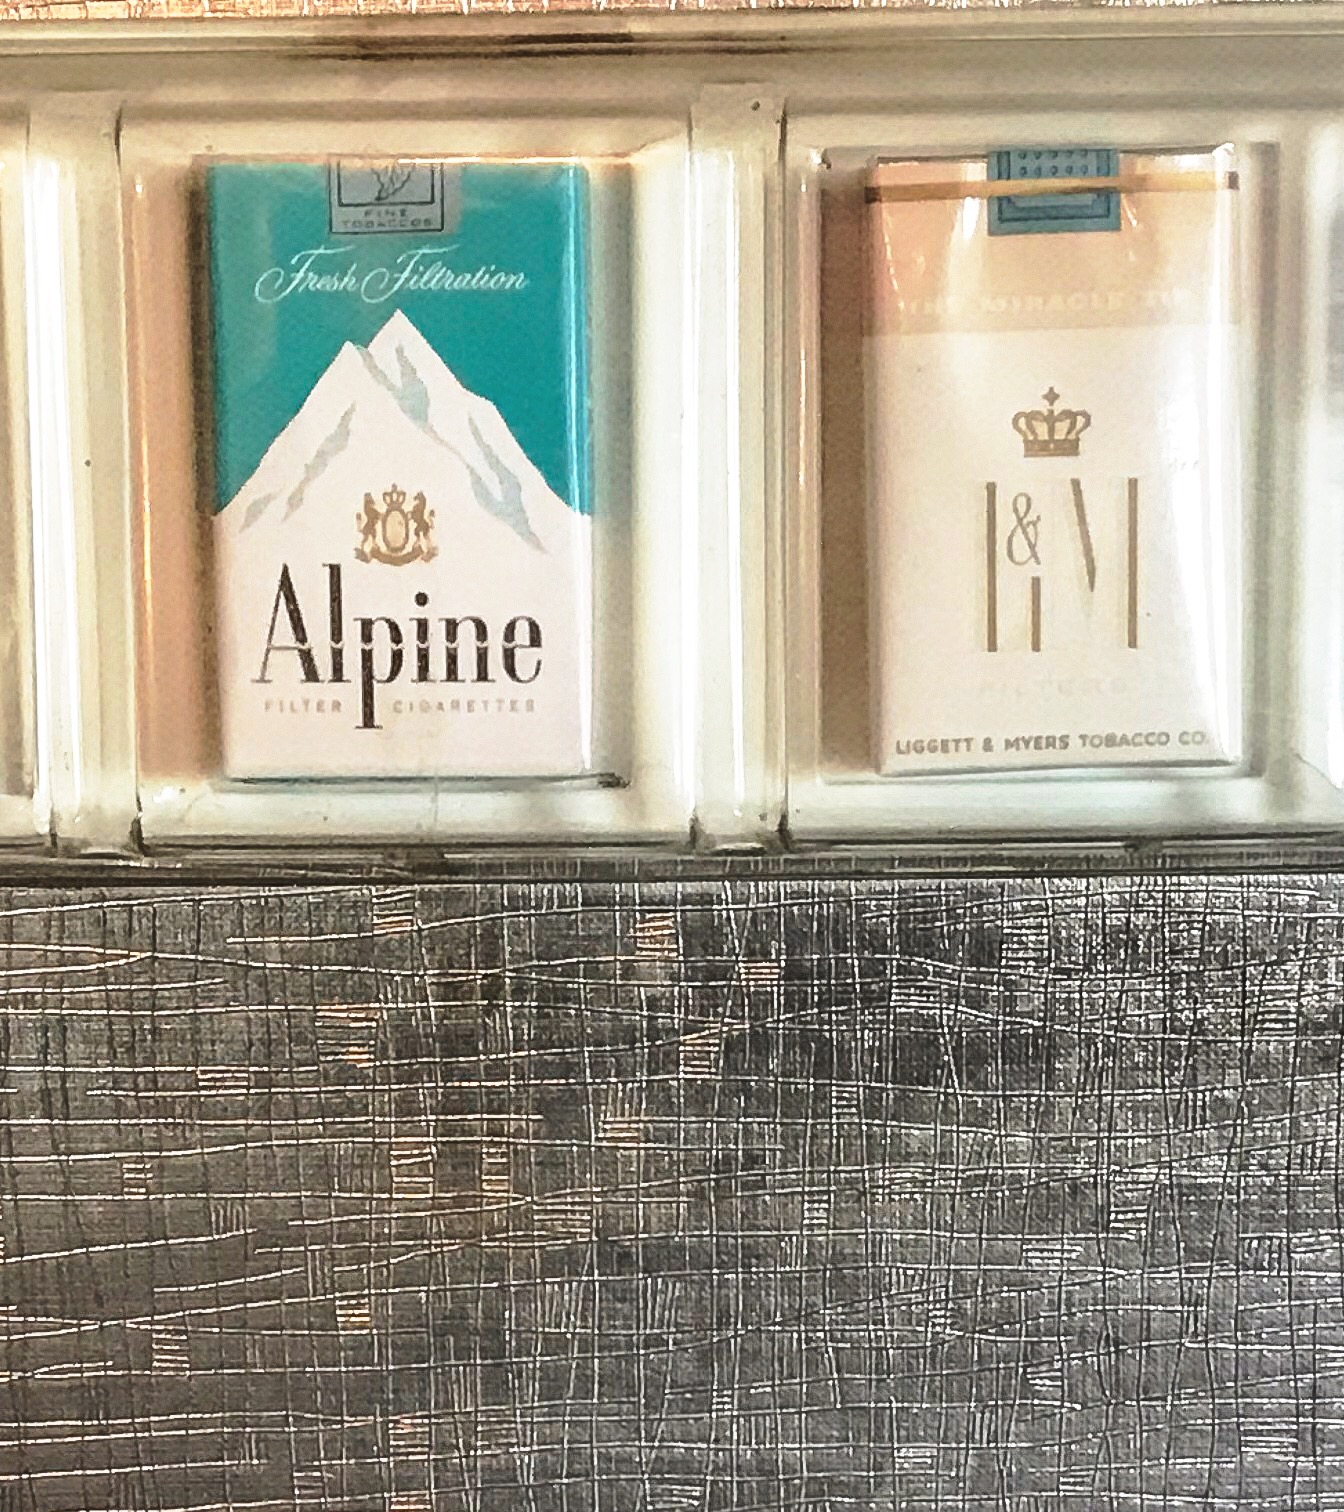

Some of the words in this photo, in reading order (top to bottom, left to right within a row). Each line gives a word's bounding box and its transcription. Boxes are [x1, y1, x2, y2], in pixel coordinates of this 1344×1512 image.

[254, 245, 360, 303] Fresh
[361, 244, 529, 302] Filtration
[250, 562, 543, 730] Alpine
[264, 699, 342, 713] FILTER
[393, 698, 535, 714] CIGARETTES
[895, 736, 974, 755] LIGGETT
[982, 736, 994, 752] &
[1004, 734, 1070, 752] MYERS
[1078, 731, 1170, 750] TOBACCO
